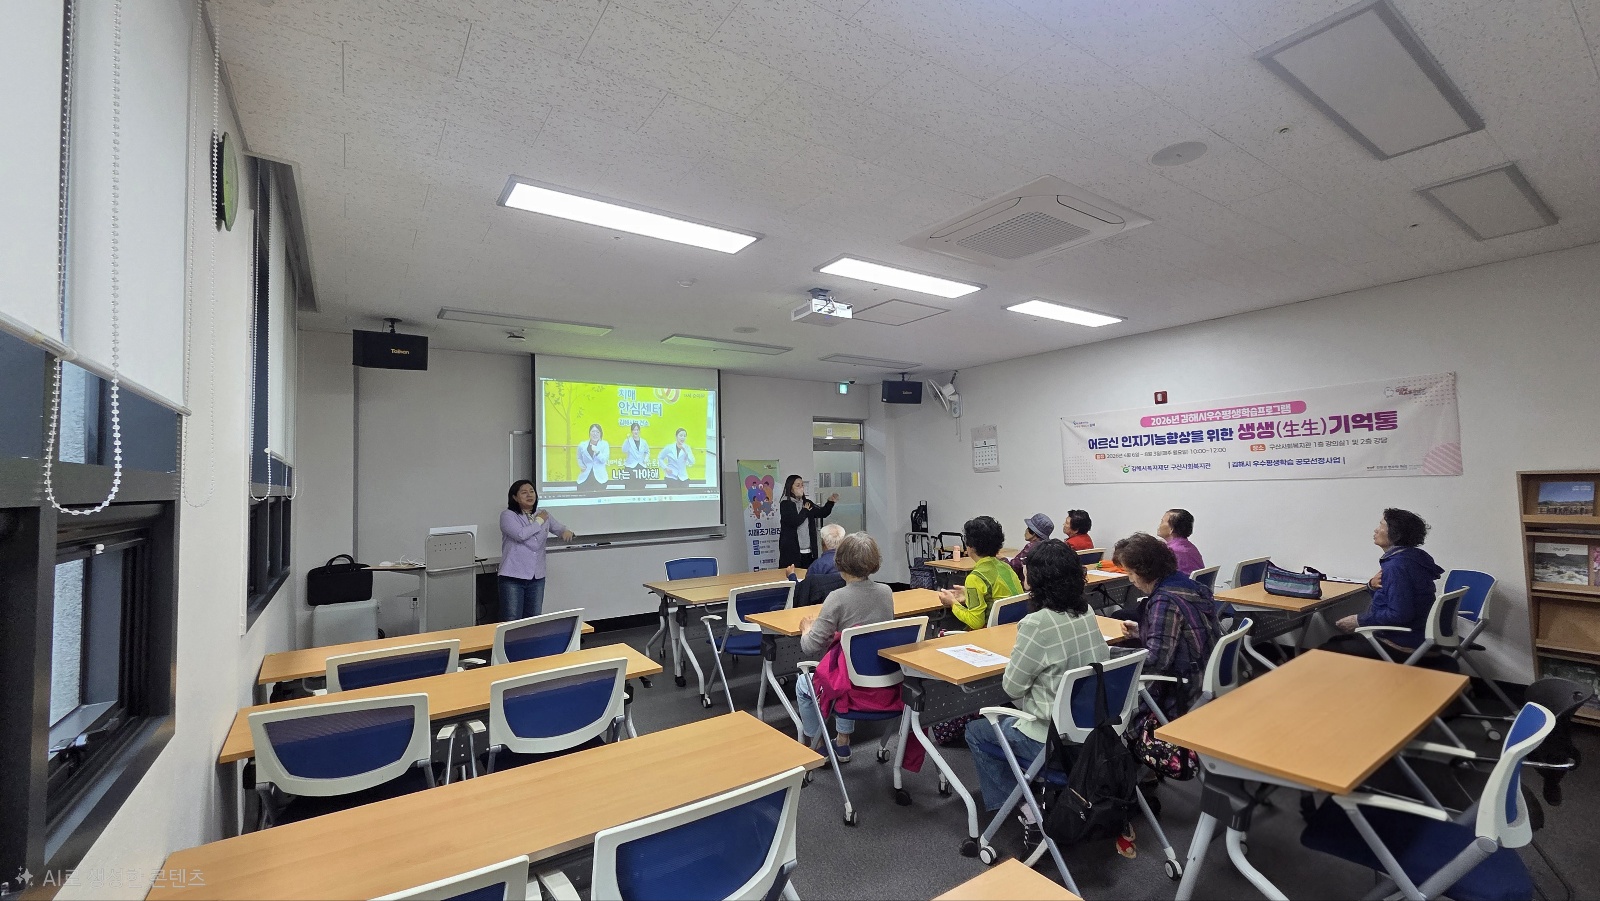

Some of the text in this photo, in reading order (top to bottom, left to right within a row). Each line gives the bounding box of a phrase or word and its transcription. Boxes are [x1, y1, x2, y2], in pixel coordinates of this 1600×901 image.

[618, 389, 636, 400] 치매
[618, 401, 662, 416] 안심센터
[1151, 414, 1180, 426] 2026년
[1088, 437, 1119, 450] 어르신
[1121, 430, 1204, 448] 인지기능향상을
[1207, 428, 1234, 442] 위한
[612, 468, 660, 479] 나는 가야해
